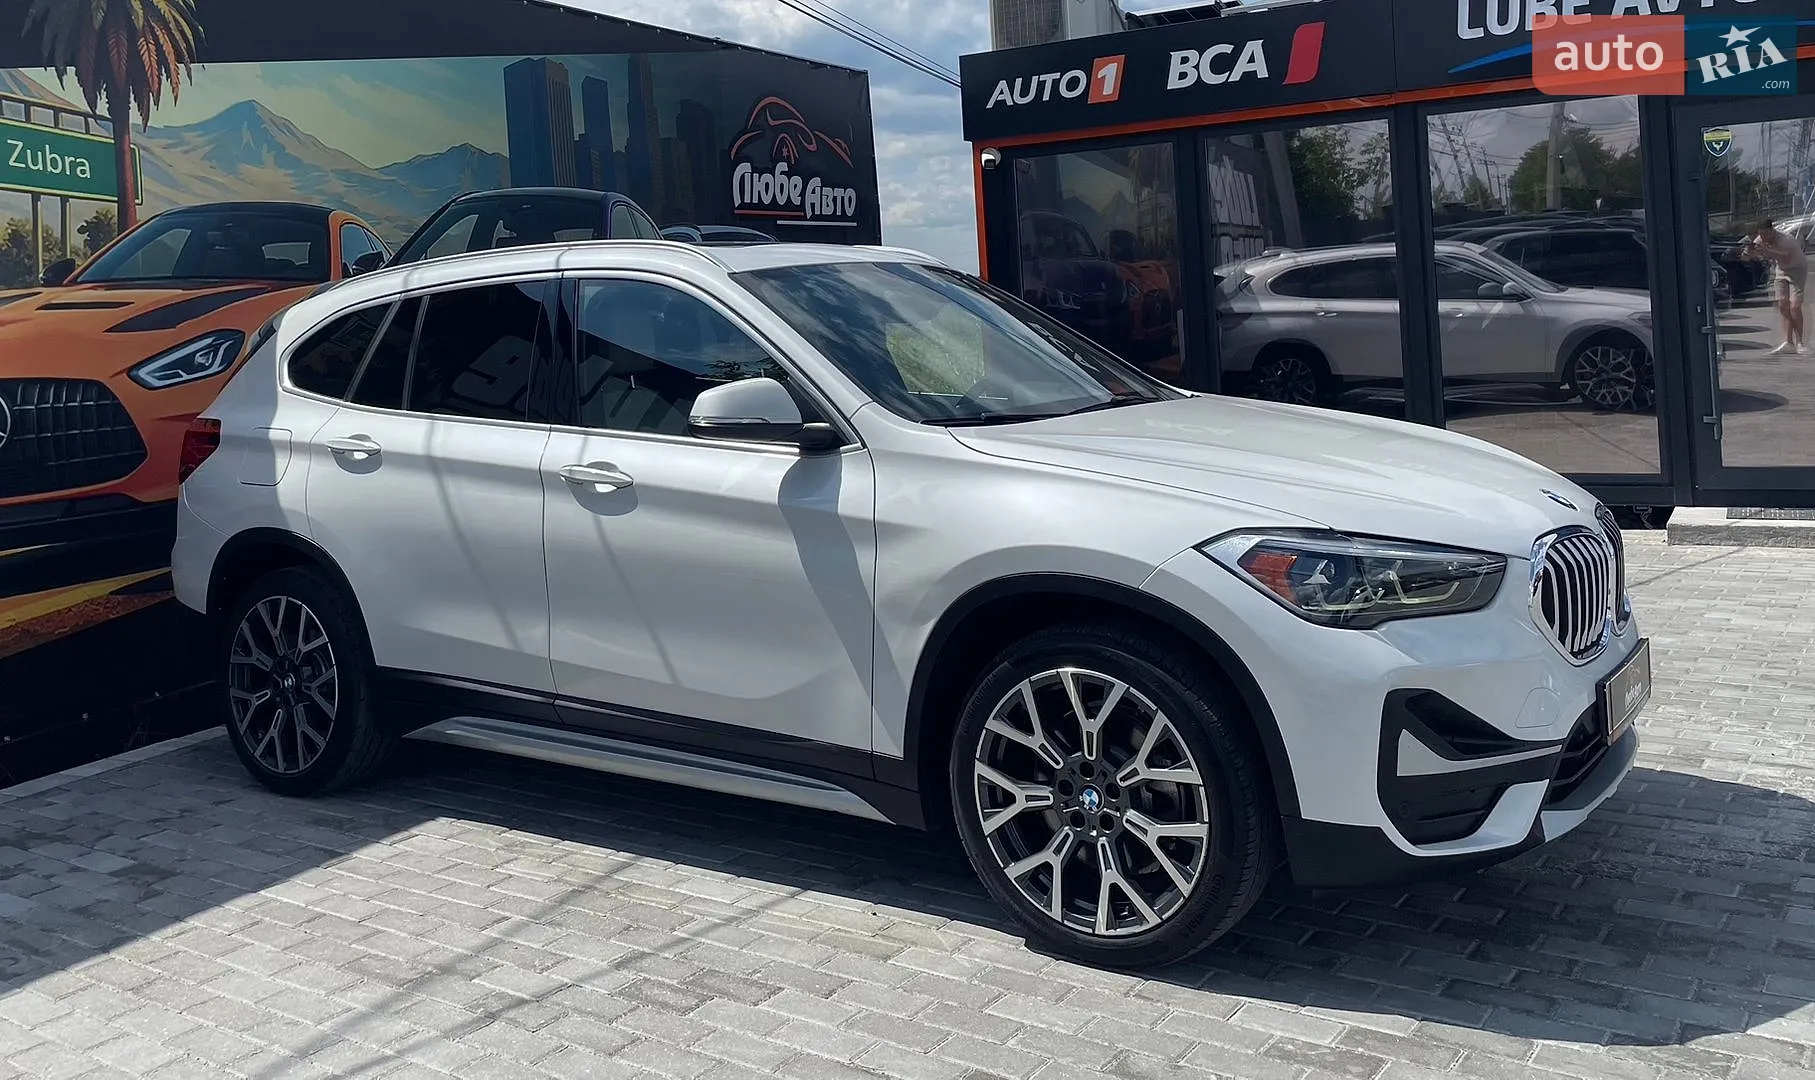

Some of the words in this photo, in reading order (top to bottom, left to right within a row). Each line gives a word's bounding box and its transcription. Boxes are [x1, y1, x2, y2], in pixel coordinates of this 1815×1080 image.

[1167, 39, 1269, 90] BCA
[7, 139, 91, 179] Zubra
[732, 162, 803, 208] Любе
[805, 177, 857, 219] Авто
